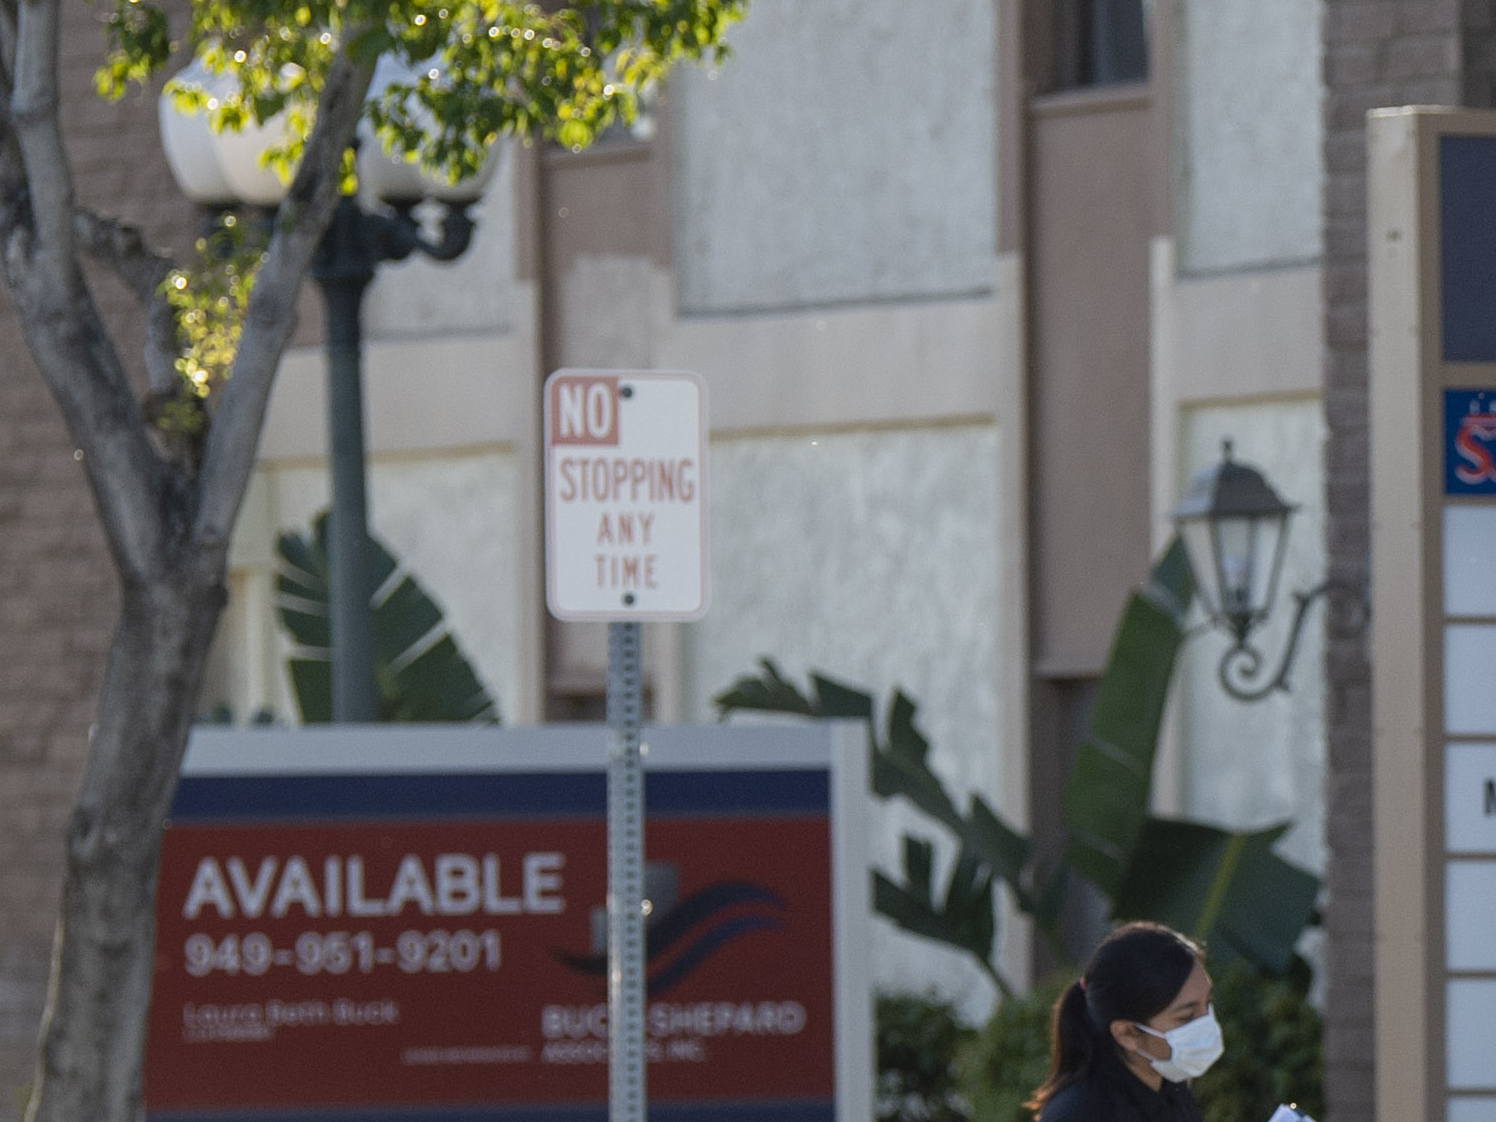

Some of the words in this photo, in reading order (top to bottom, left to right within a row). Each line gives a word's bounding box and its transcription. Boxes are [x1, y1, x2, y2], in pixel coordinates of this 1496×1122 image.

[559, 382, 613, 438] NO
[559, 457, 695, 503] STOPPING
[597, 512, 655, 544] ANY
[595, 555, 658, 588] TIME
[183, 852, 566, 919] AVAILABLE
[183, 930, 501, 977] 949-951-9201
[541, 1003, 608, 1039] BUC
[648, 1002, 808, 1036] SHEPARD
